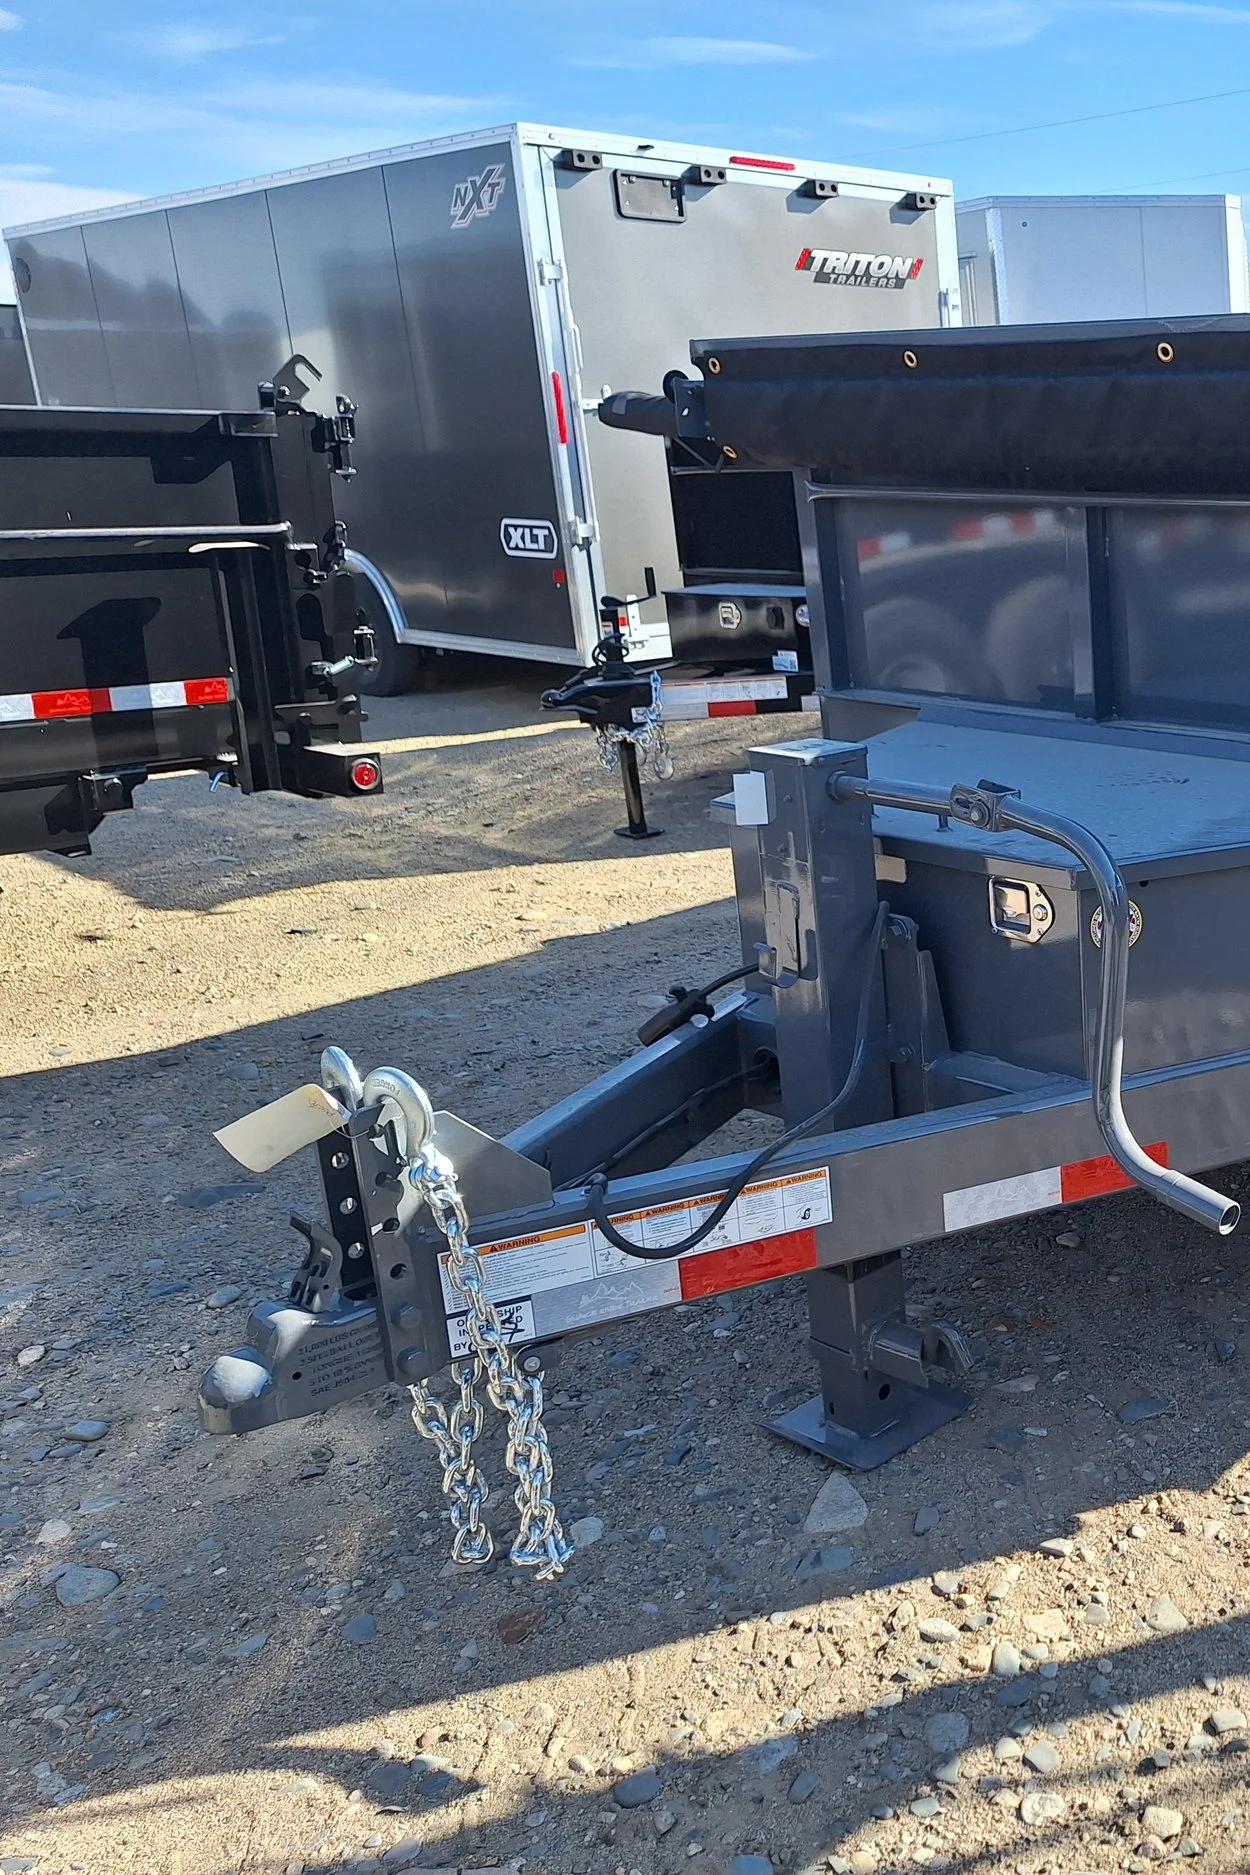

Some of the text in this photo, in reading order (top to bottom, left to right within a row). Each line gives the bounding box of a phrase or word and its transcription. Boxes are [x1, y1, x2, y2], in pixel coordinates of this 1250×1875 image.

[451, 163, 506, 229] NXT
[810, 249, 913, 279] TRITON
[829, 274, 896, 288] TRAILERS
[507, 526, 549, 550] XLT
[651, 1203, 685, 1215] WARNING
[498, 1236, 541, 1251] WARNING
[454, 1342, 467, 1351] BY
